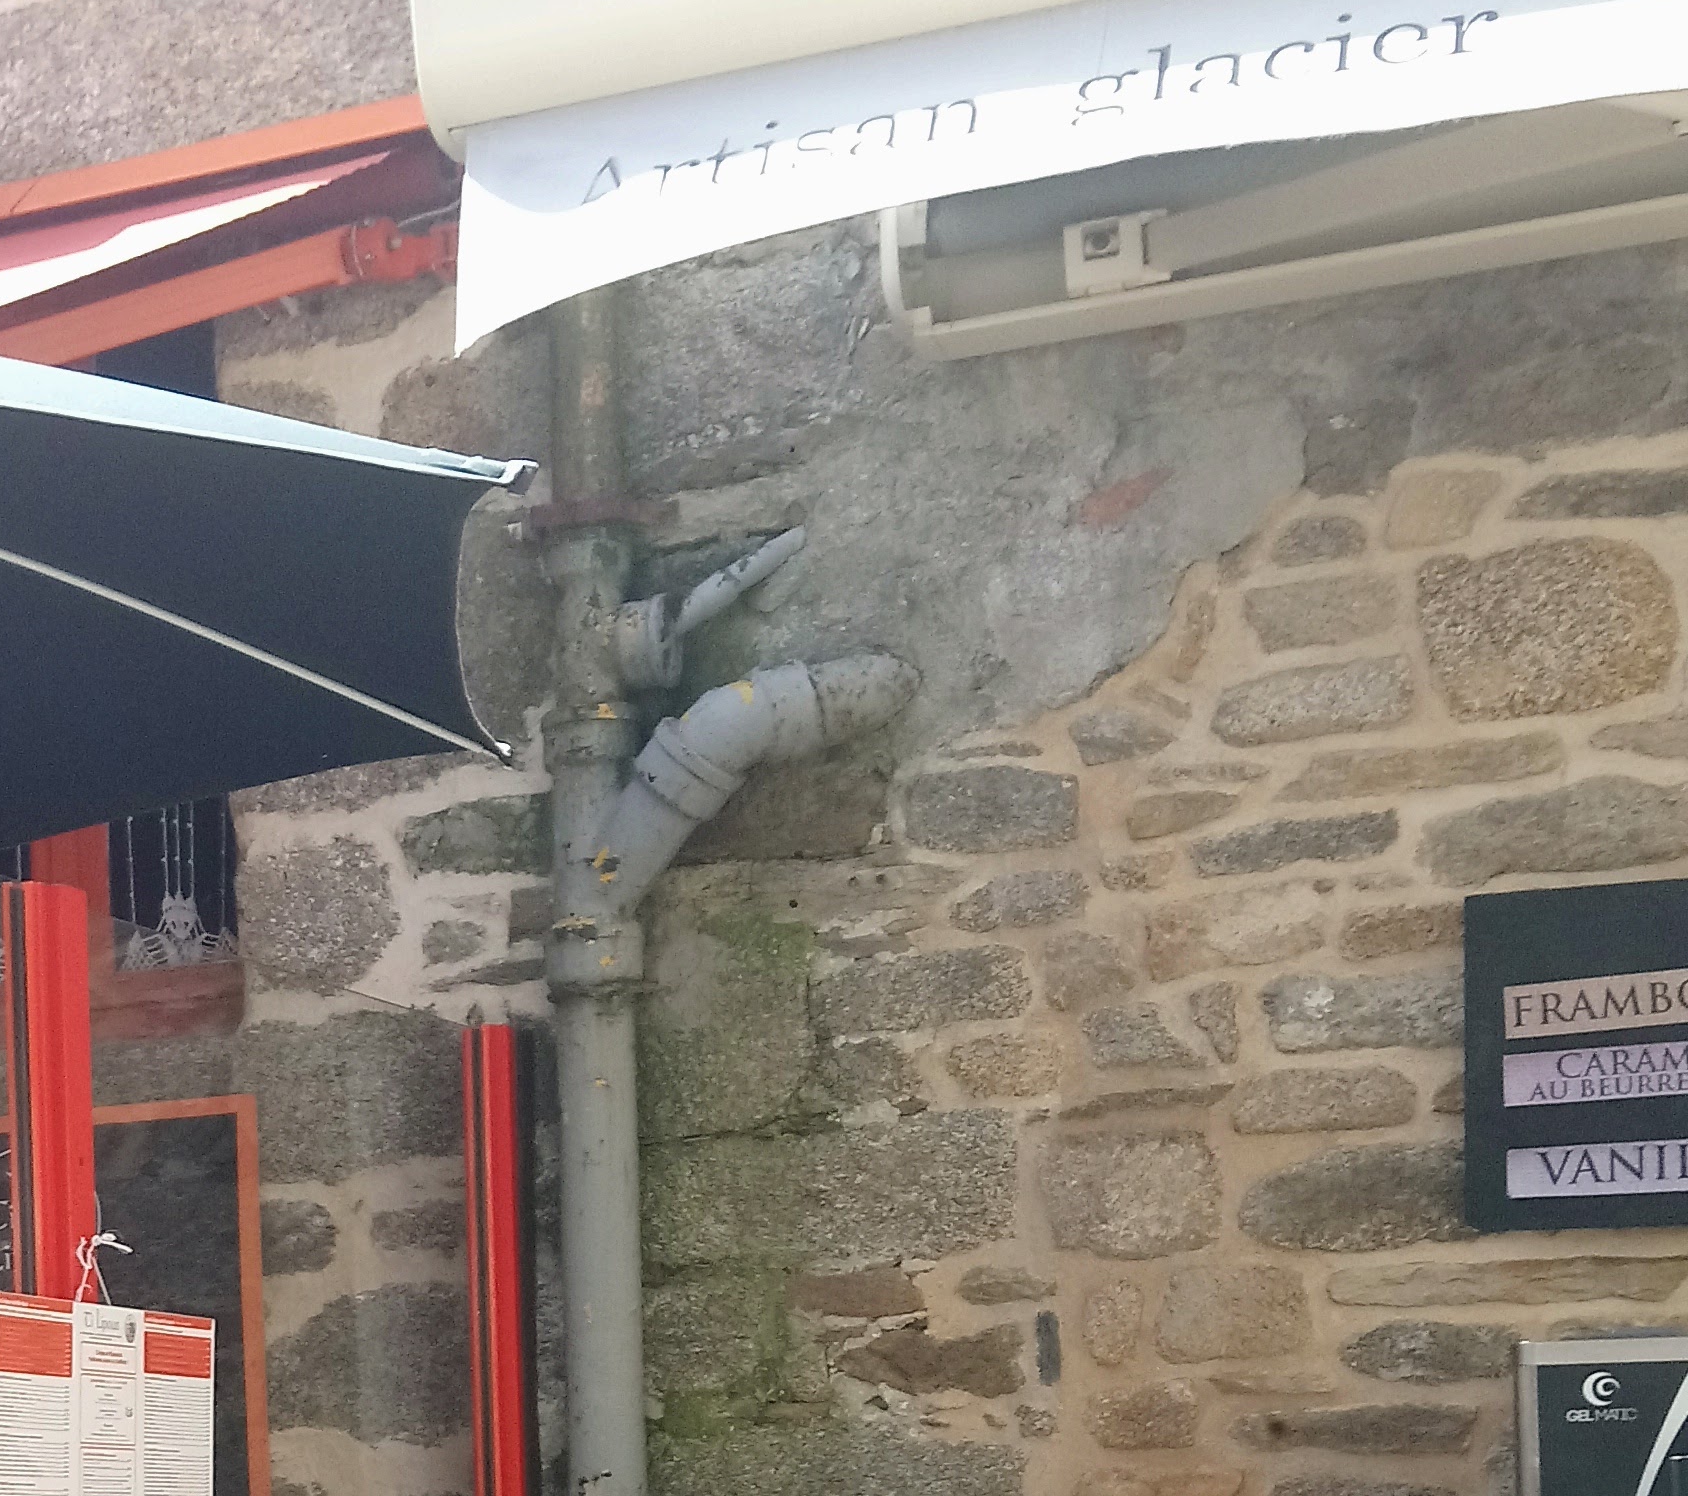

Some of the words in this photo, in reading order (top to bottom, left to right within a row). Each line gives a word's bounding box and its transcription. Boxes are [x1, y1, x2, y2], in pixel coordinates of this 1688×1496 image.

[582, 98, 977, 205] Artisan
[1071, 10, 1499, 126] glacier
[1527, 1080, 1568, 1102] AU
[1581, 1072, 1688, 1098] BEURRE
